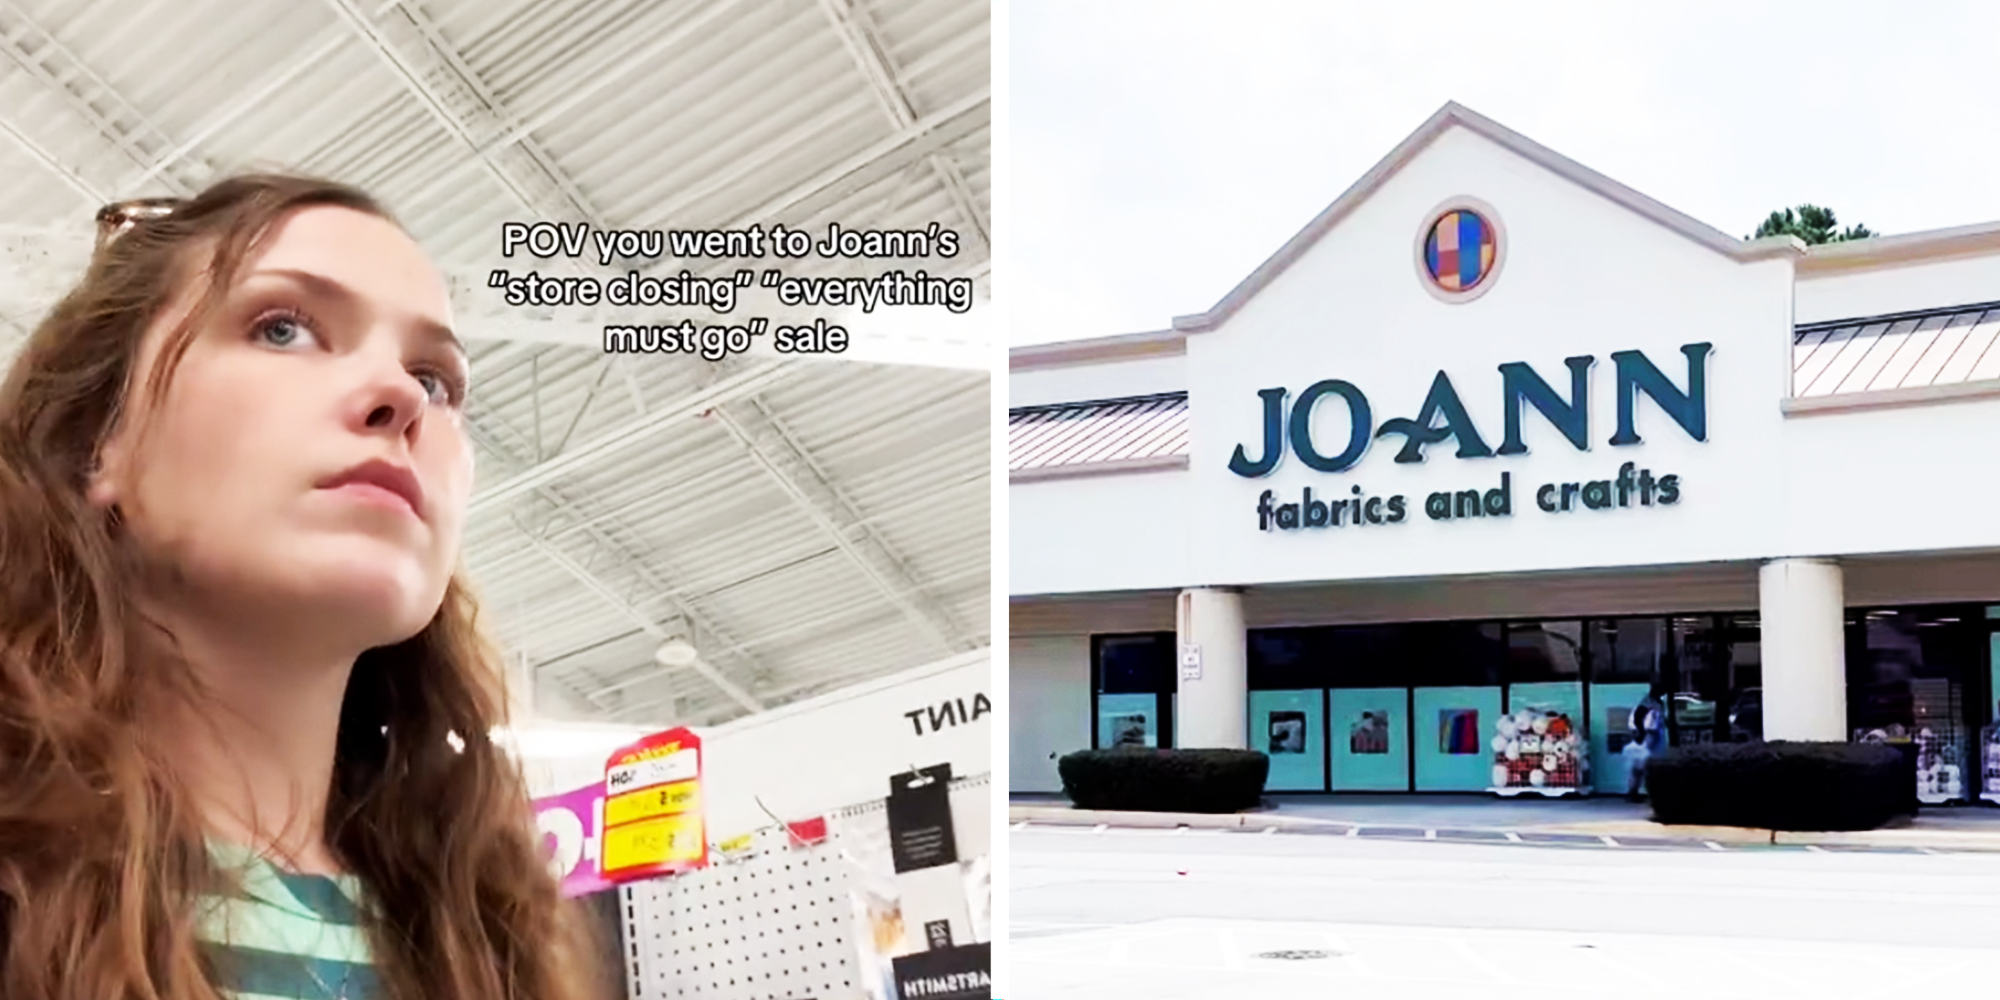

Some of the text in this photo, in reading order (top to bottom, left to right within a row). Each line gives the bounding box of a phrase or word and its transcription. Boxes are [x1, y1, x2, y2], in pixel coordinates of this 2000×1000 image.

[1228, 342, 1713, 478] JOANN
[1257, 463, 1681, 530] fabrics and crafts
